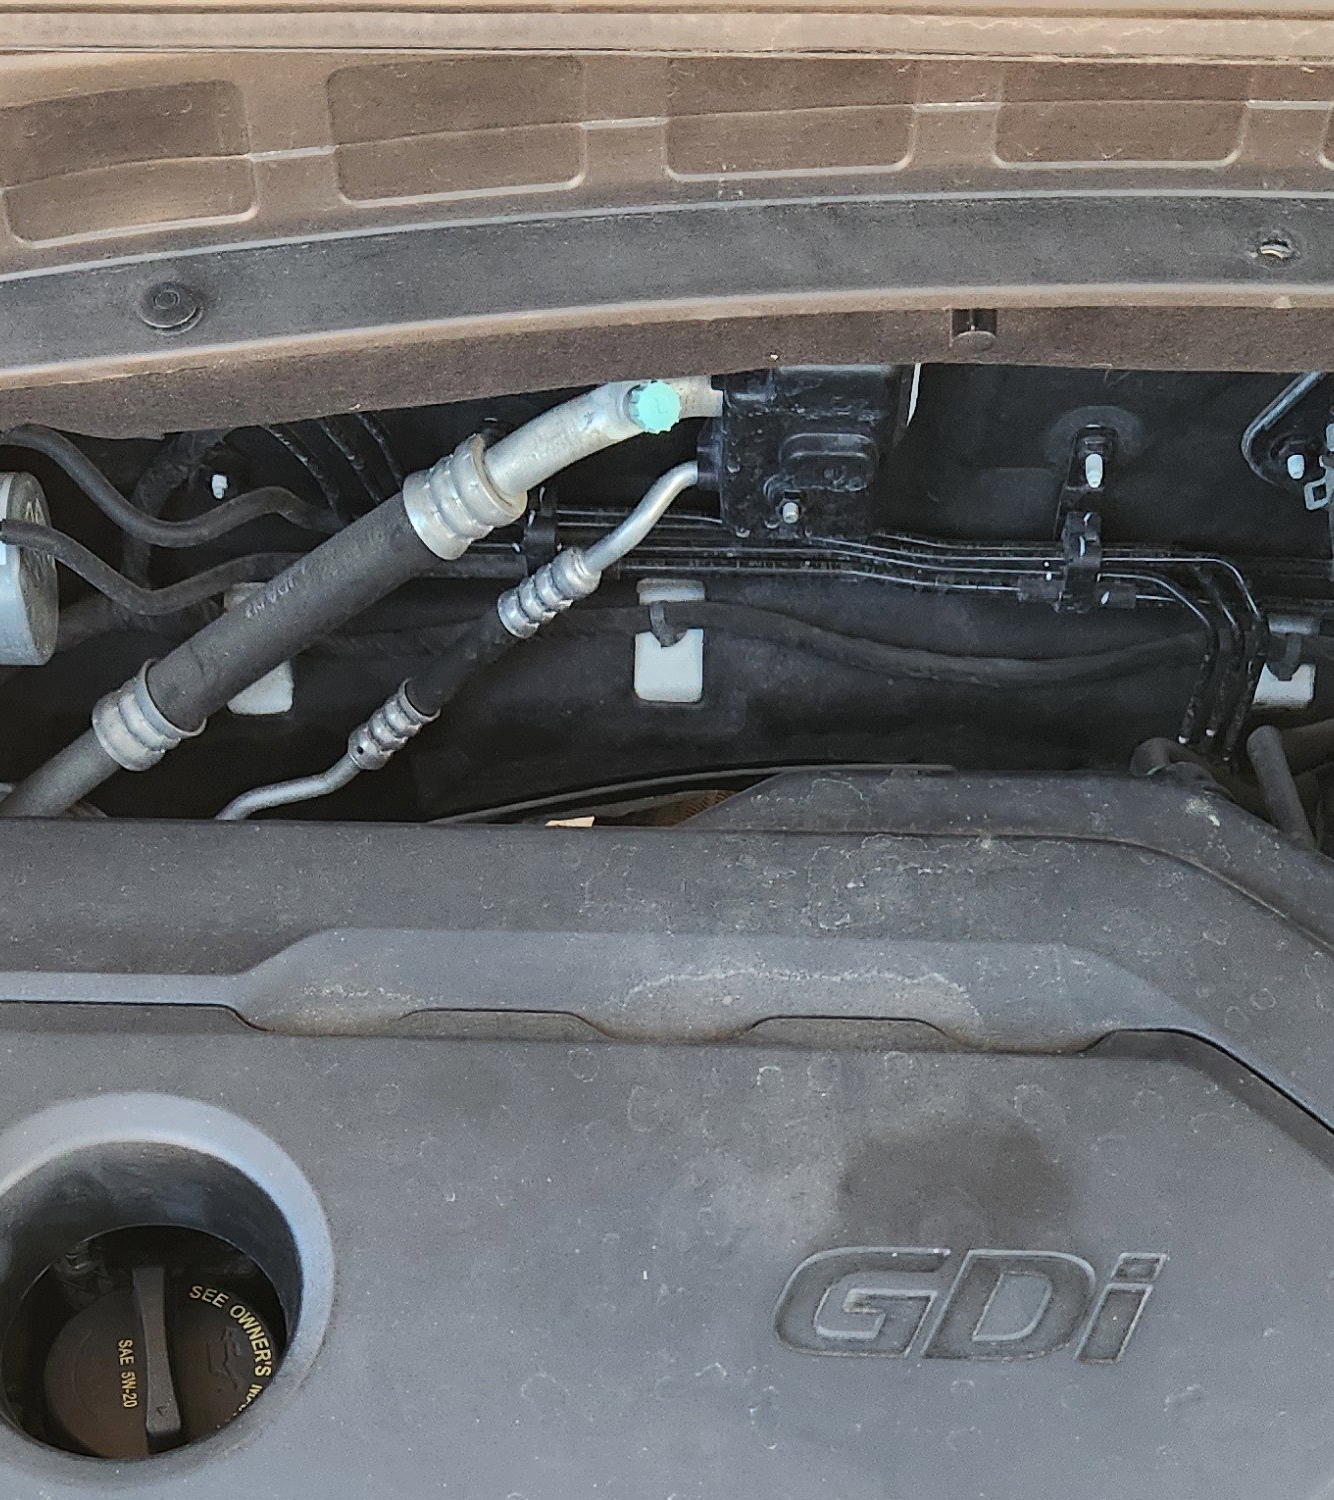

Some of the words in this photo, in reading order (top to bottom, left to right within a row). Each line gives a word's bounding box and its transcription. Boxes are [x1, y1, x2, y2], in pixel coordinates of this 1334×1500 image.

[188, 1284, 229, 1309] SEE
[229, 1304, 273, 1377] OWNER'S
[773, 1246, 1169, 1366] GDi
[117, 1338, 136, 1367] SAE
[121, 1370, 139, 1409] 5W-20
